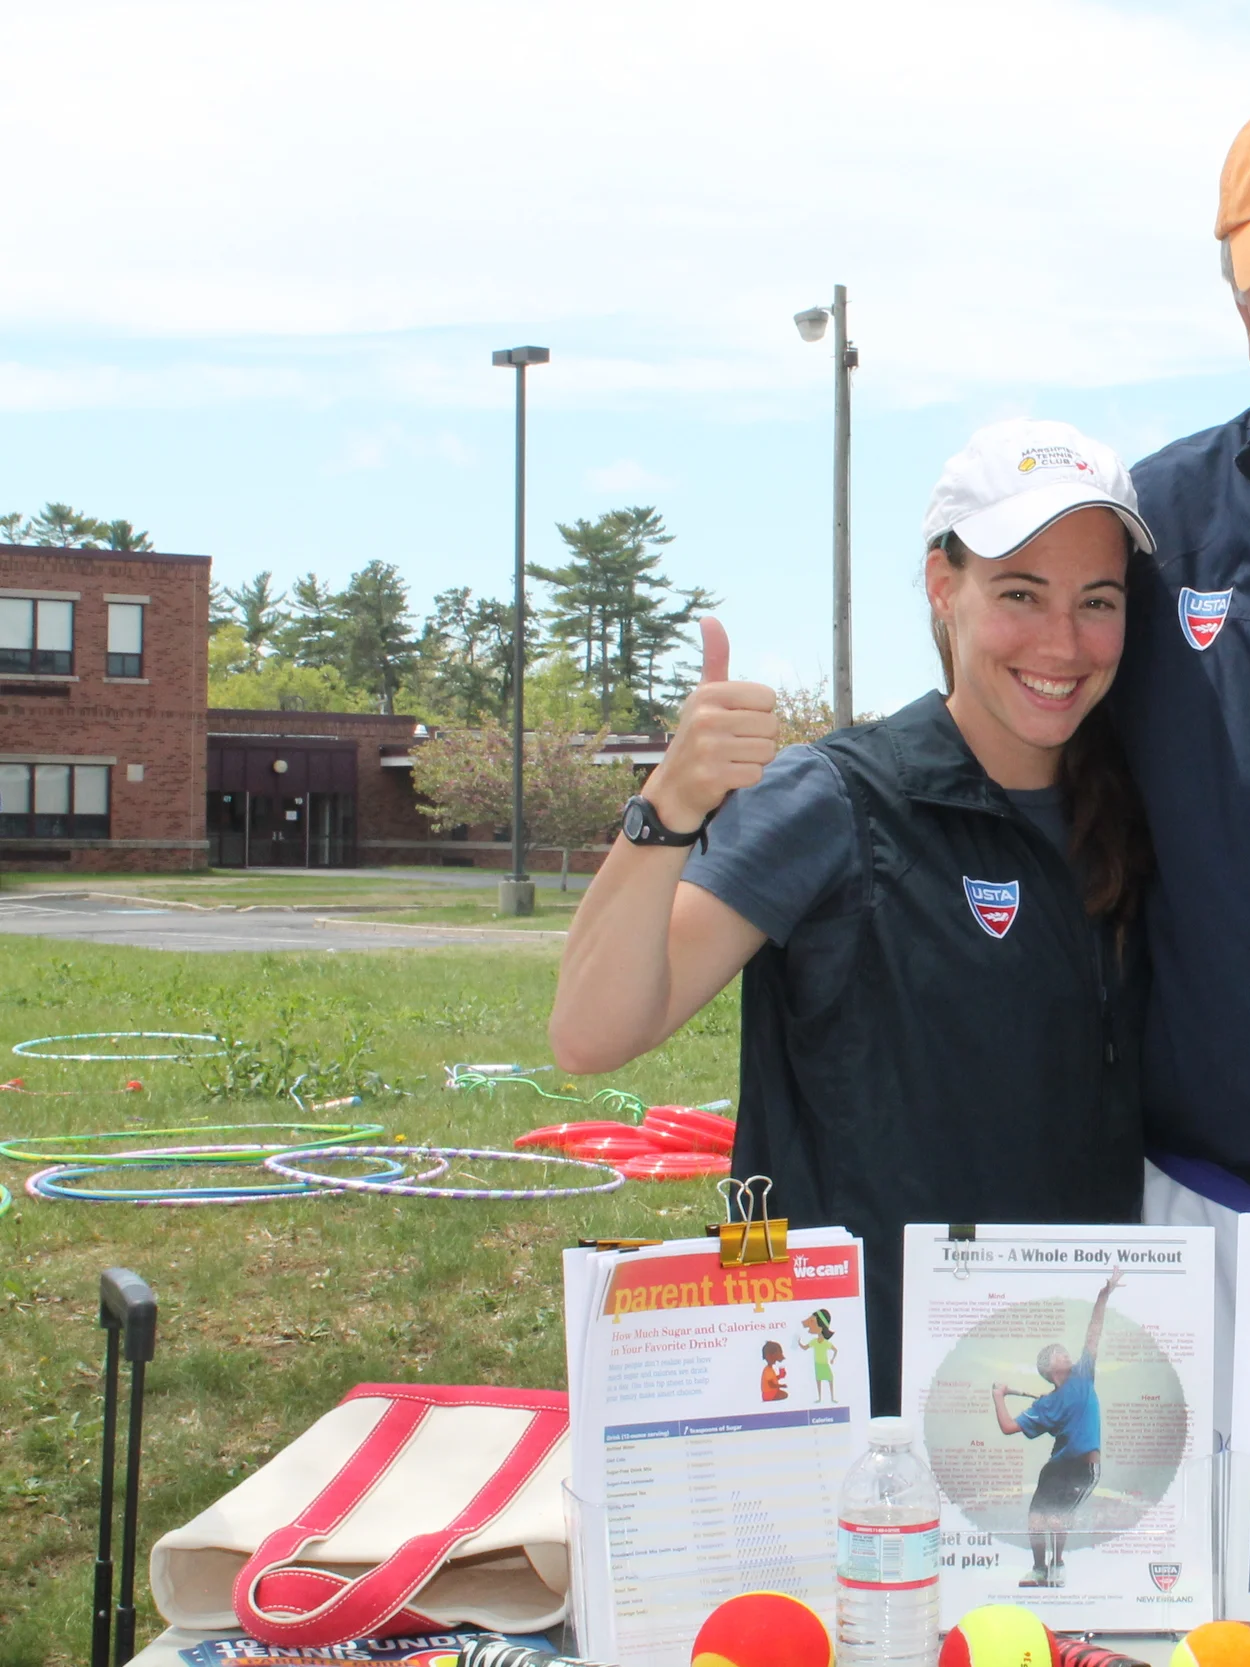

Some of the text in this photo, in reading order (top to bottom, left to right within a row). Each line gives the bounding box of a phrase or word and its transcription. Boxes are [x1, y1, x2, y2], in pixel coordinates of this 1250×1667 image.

[1190, 598, 1226, 611] USTA
[971, 886, 1015, 902] USTA
[942, 1247, 1182, 1265] Tennis A Whole Body Workout
[612, 1271, 794, 1324] parent tips
[612, 1319, 787, 1342] How Much Sugar and Calories are
[611, 1337, 728, 1357] in Your Favorite Drink?
[967, 1533, 993, 1546] out
[940, 1553, 1000, 1569] nd play!
[1153, 1566, 1178, 1575] USTA
[216, 1648, 372, 1662] TENNIS
